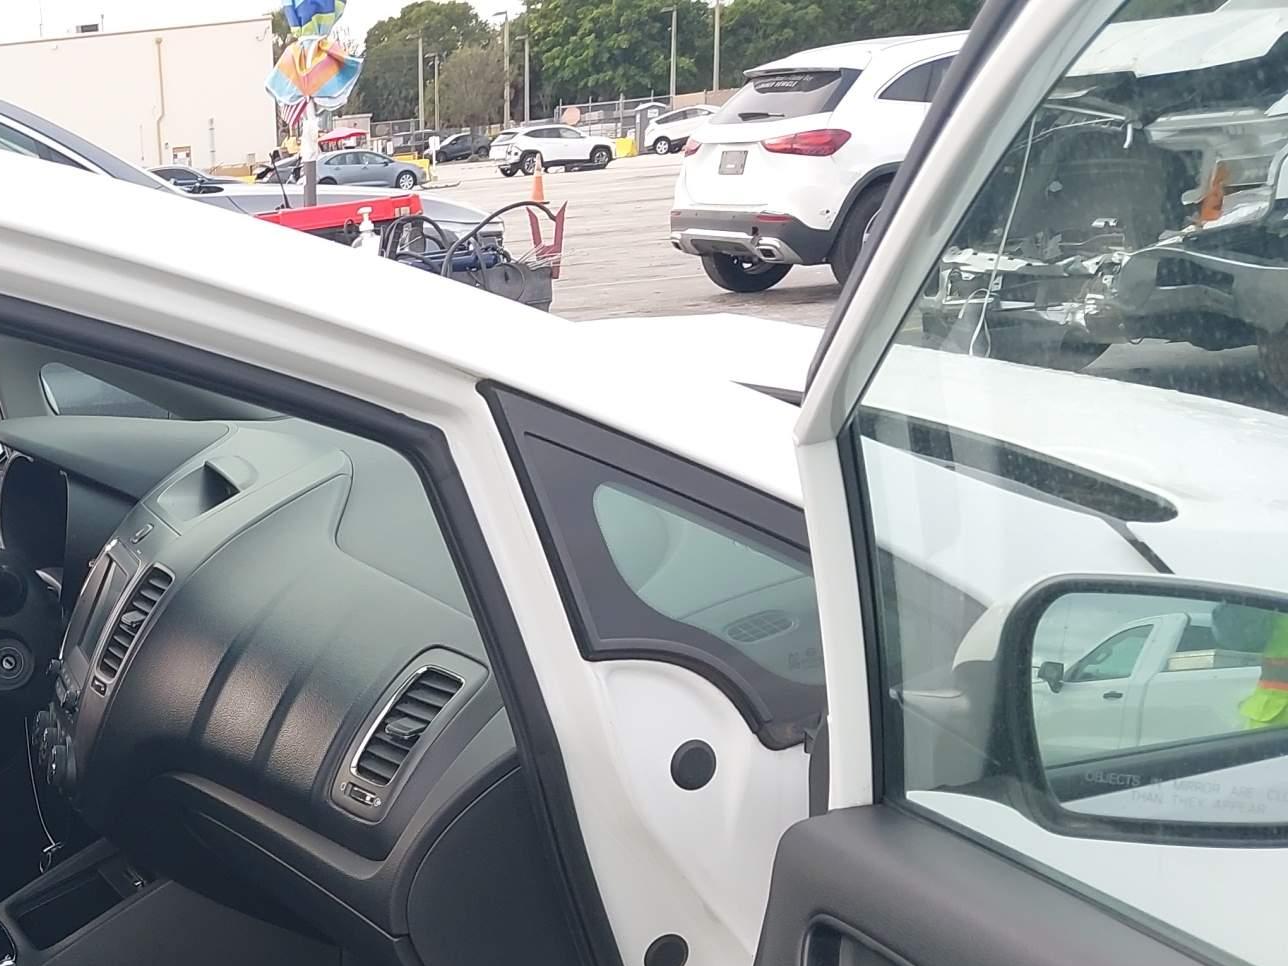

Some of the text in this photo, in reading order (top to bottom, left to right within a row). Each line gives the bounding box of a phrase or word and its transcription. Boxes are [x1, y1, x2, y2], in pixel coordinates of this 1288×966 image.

[1085, 769, 1141, 787] OBJECTS
[1173, 780, 1221, 794] MIRROR
[1231, 786, 1256, 798] ARE
[1132, 790, 1163, 804] THAN
[1214, 798, 1266, 815] APPEAR
